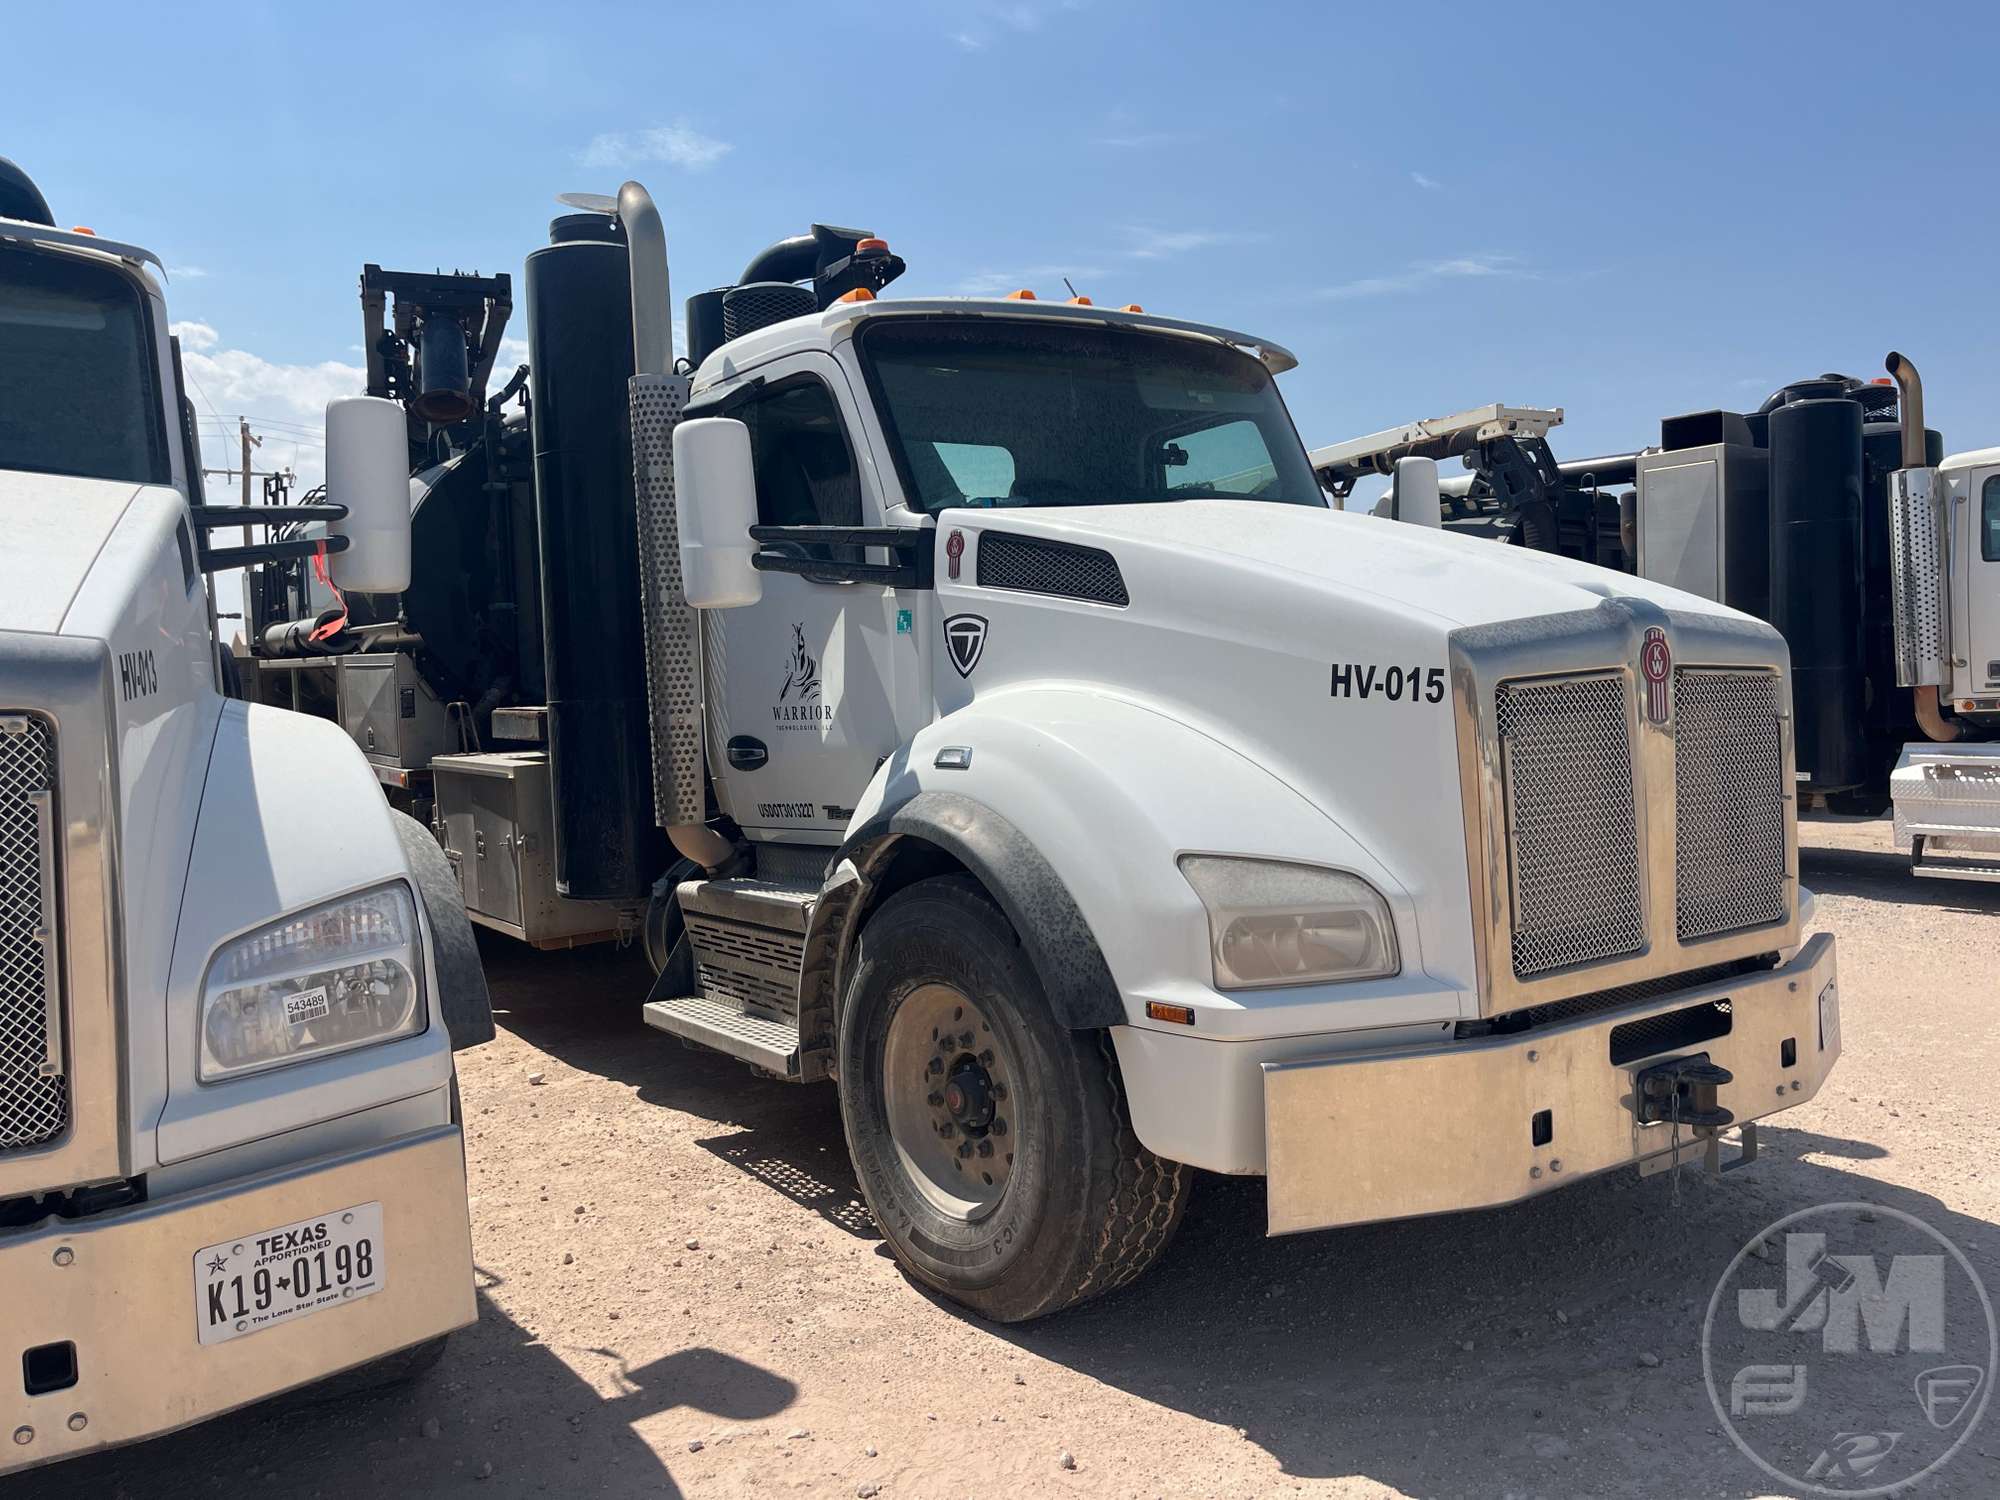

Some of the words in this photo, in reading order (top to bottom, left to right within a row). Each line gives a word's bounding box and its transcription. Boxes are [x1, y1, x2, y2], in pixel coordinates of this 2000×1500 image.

[119, 649, 158, 702] HV-013
[1330, 663, 1445, 704] HV-015
[772, 704, 833, 721] WARRIOR
[757, 803, 815, 818] USDOT3013227
[287, 994, 325, 1014] 543489
[253, 1239, 332, 1268] APPORTIONED
[256, 1222, 328, 1257] TEXAS
[251, 1314, 270, 1325] The
[271, 1307, 294, 1319] Lone
[295, 1300, 315, 1312] Star
[316, 1292, 340, 1305] State
